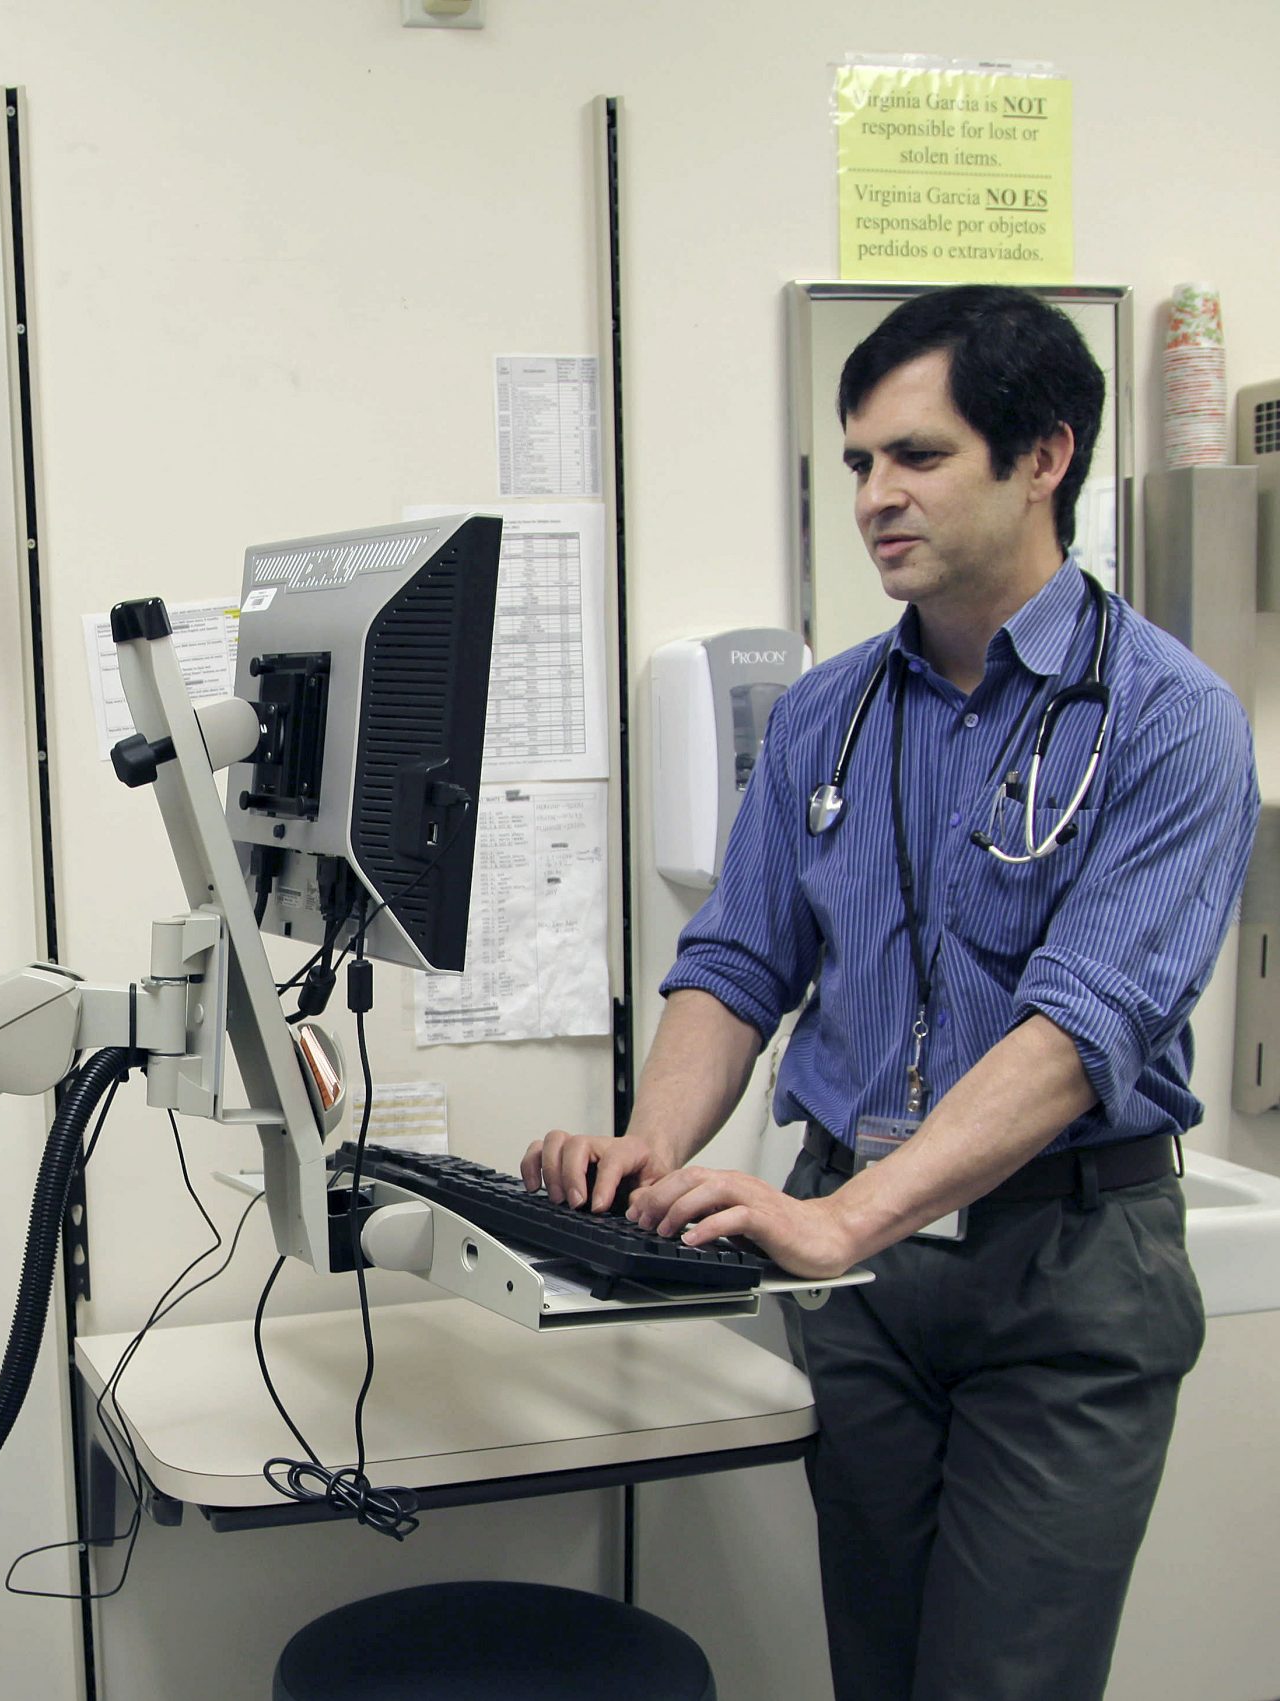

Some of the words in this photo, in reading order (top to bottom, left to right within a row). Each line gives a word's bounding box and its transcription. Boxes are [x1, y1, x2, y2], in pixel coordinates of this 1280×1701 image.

[854, 89, 920, 113] Virginia
[926, 92, 980, 112] Garcia
[985, 95, 998, 112] is
[1003, 95, 1048, 115] NOT
[862, 120, 955, 139] responsible
[961, 121, 984, 139] for
[989, 121, 1018, 140] lost
[1022, 129, 1039, 141] or
[900, 146, 949, 165] stolen
[954, 148, 1002, 167] items.
[854, 184, 921, 207] Virginia
[927, 186, 981, 206] Garcia
[986, 188, 1017, 207] NO
[1023, 189, 1048, 208] ES
[856, 214, 952, 234] responsable
[957, 219, 985, 237] por
[989, 216, 1046, 238] objetos
[858, 239, 929, 260] perdidos
[933, 246, 943, 256] o
[948, 243, 1044, 261] extraviados.
